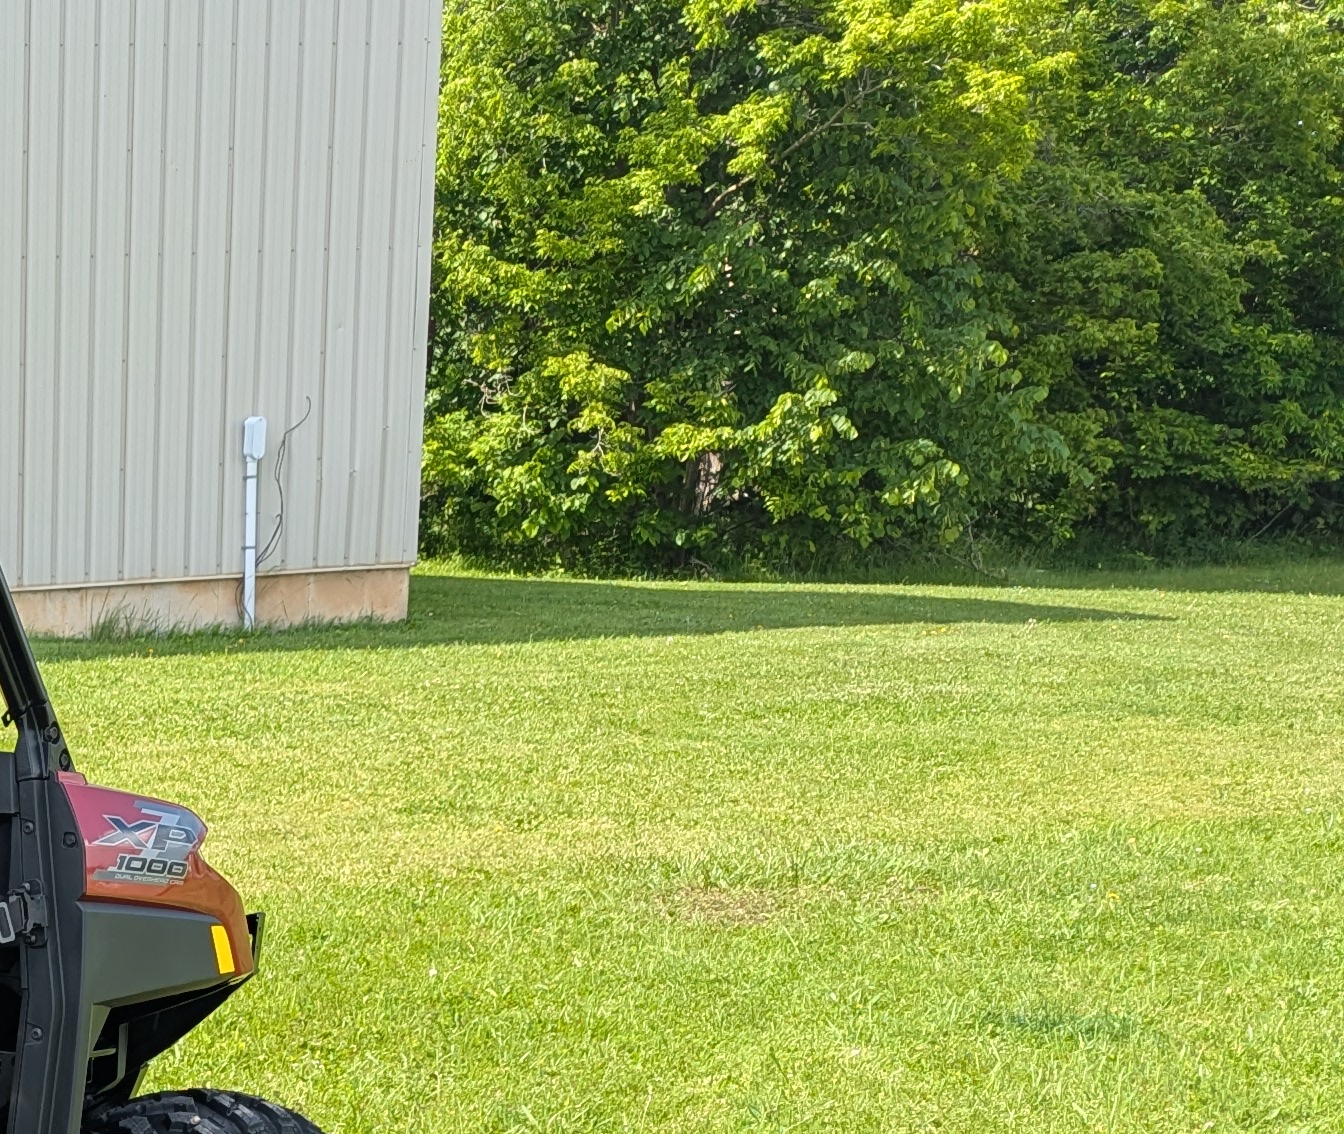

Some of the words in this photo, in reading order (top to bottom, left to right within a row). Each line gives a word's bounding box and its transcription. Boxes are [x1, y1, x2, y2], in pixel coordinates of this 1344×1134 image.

[92, 814, 198, 851] XP
[114, 873, 133, 881] DUAL
[117, 854, 189, 879] 1000
